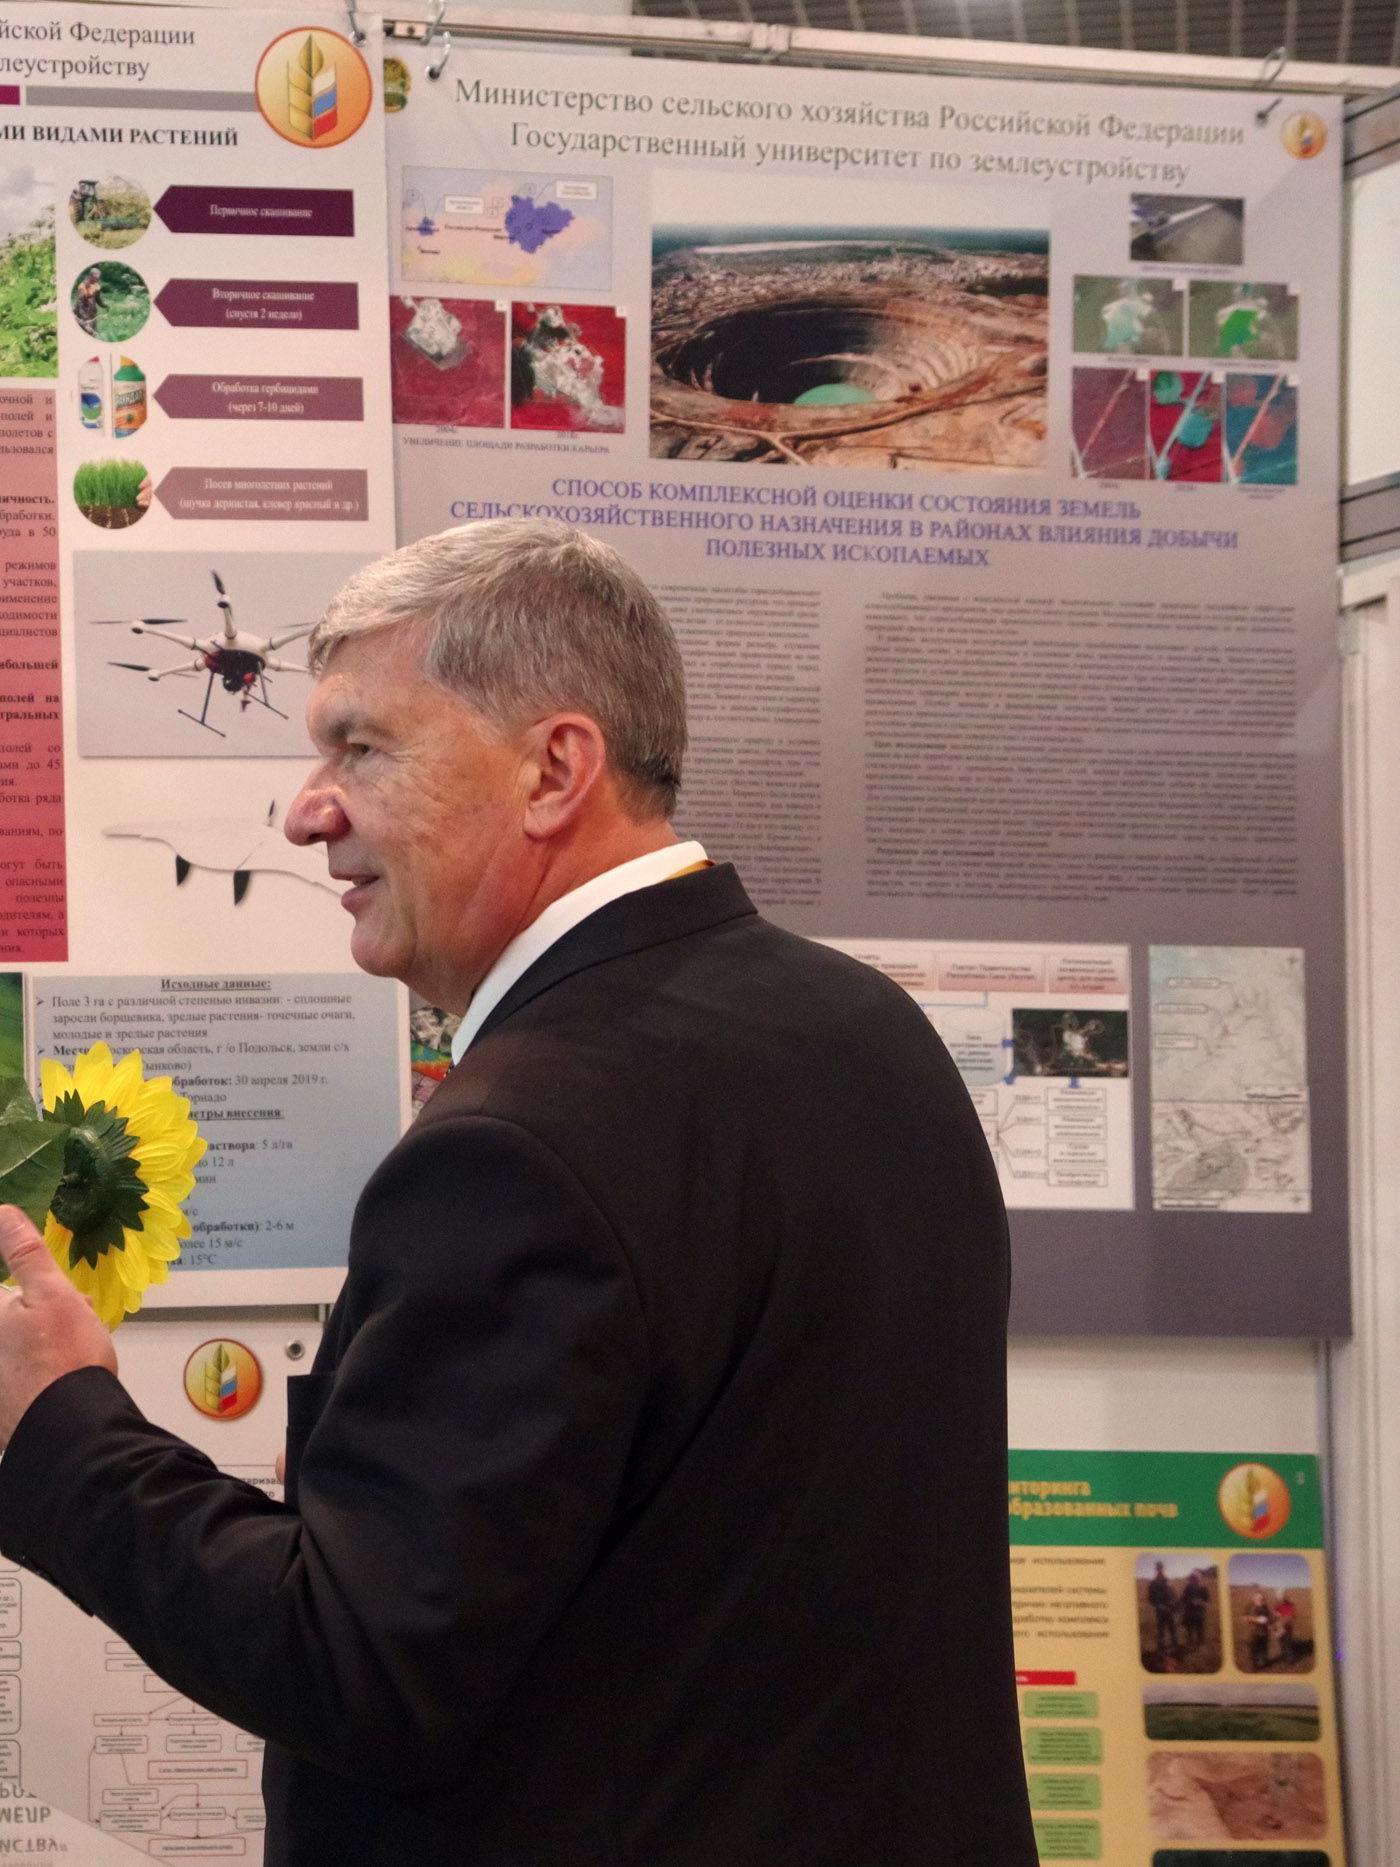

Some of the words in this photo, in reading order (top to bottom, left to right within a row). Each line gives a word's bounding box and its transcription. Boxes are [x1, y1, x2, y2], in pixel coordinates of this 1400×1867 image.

[70, 23, 195, 47] Федерации
[455, 78, 652, 114] Министерство
[662, 95, 791, 120] сельского
[801, 101, 930, 130] хозяйства
[939, 104, 1090, 137] Российской
[1099, 114, 1244, 146] Федерации
[33, 127, 123, 145] ВИДАМИ
[130, 125, 239, 146] РАСТЕНИЙ
[511, 121, 746, 159] Государственный
[755, 140, 920, 173] университет
[930, 152, 960, 170] по
[971, 153, 1190, 187] землеустройству
[210, 203, 258, 217] Первичное
[212, 287, 260, 300] Вторичное
[261, 307, 266, 317] 2
[212, 380, 259, 395] Обработка
[262, 383, 319, 396] гербицидами
[552, 478, 642, 498] СПОСОБ
[649, 481, 817, 506] КОМПЛЕКСНОЙ
[824, 491, 913, 511] ОЦЕНКИ
[919, 494, 1051, 514] СОСТОЯНИЯ
[1058, 499, 1141, 519] ЗЕМЕЛЬ
[760, 514, 902, 537] НАЗНАЧЕНИЯ
[910, 520, 923, 537] В
[929, 521, 1031, 541] РАЙОНАХ
[1038, 524, 1141, 545] ВЛИЯНИЯ
[1147, 528, 1238, 549] ДОБЫЧИ
[706, 538, 825, 560] ПОЛЕЗНЫХ
[833, 545, 989, 566] ИСКОПАЕМЫХ
[161, 977, 220, 991] Исходные
[223, 977, 271, 991] данные:
[52, 995, 82, 1008] Поле
[117, 995, 176, 1009] различной
[178, 996, 232, 1007] степенью
[294, 993, 351, 1006] сплошные
[53, 1012, 97, 1025] заросли
[100, 1011, 164, 1025] борщевика,
[167, 1011, 206, 1024] зрелые
[266, 1009, 319, 1021] точечные
[53, 1028, 102, 1040] молодые
[116, 1027, 155, 1041] зрелые
[157, 1027, 208, 1041] растения
[167, 1041, 213, 1056] область,
[239, 1041, 296, 1055] Подольск,
[298, 1042, 331, 1052] земли
[234, 1074, 248, 1086] 30
[251, 1075, 289, 1087] апреля
[292, 1072, 319, 1085] 2019
[180, 1091, 227, 1104] Торнадо
[227, 1107, 281, 1118] внесения
